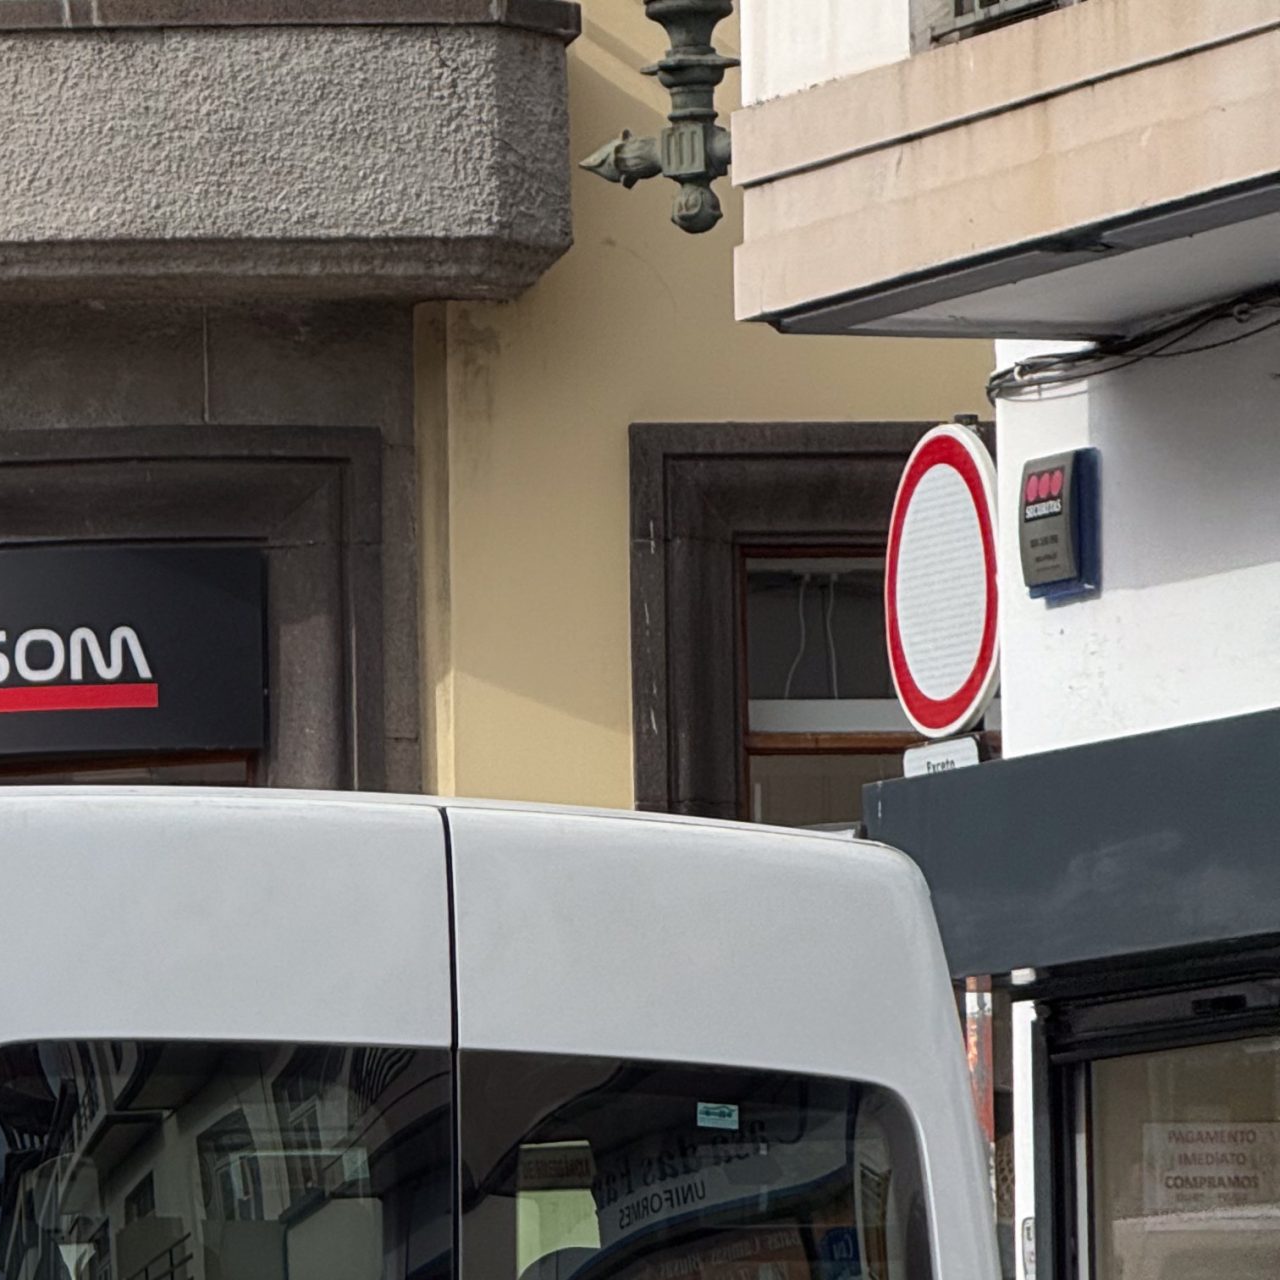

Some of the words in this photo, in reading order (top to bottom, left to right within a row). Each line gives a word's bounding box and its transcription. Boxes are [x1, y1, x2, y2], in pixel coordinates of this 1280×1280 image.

[1168, 1130, 1257, 1144] PAGAMENTO
[1178, 1151, 1246, 1166] IMEDIATO
[1164, 1175, 1260, 1189] COMPRAMOS
